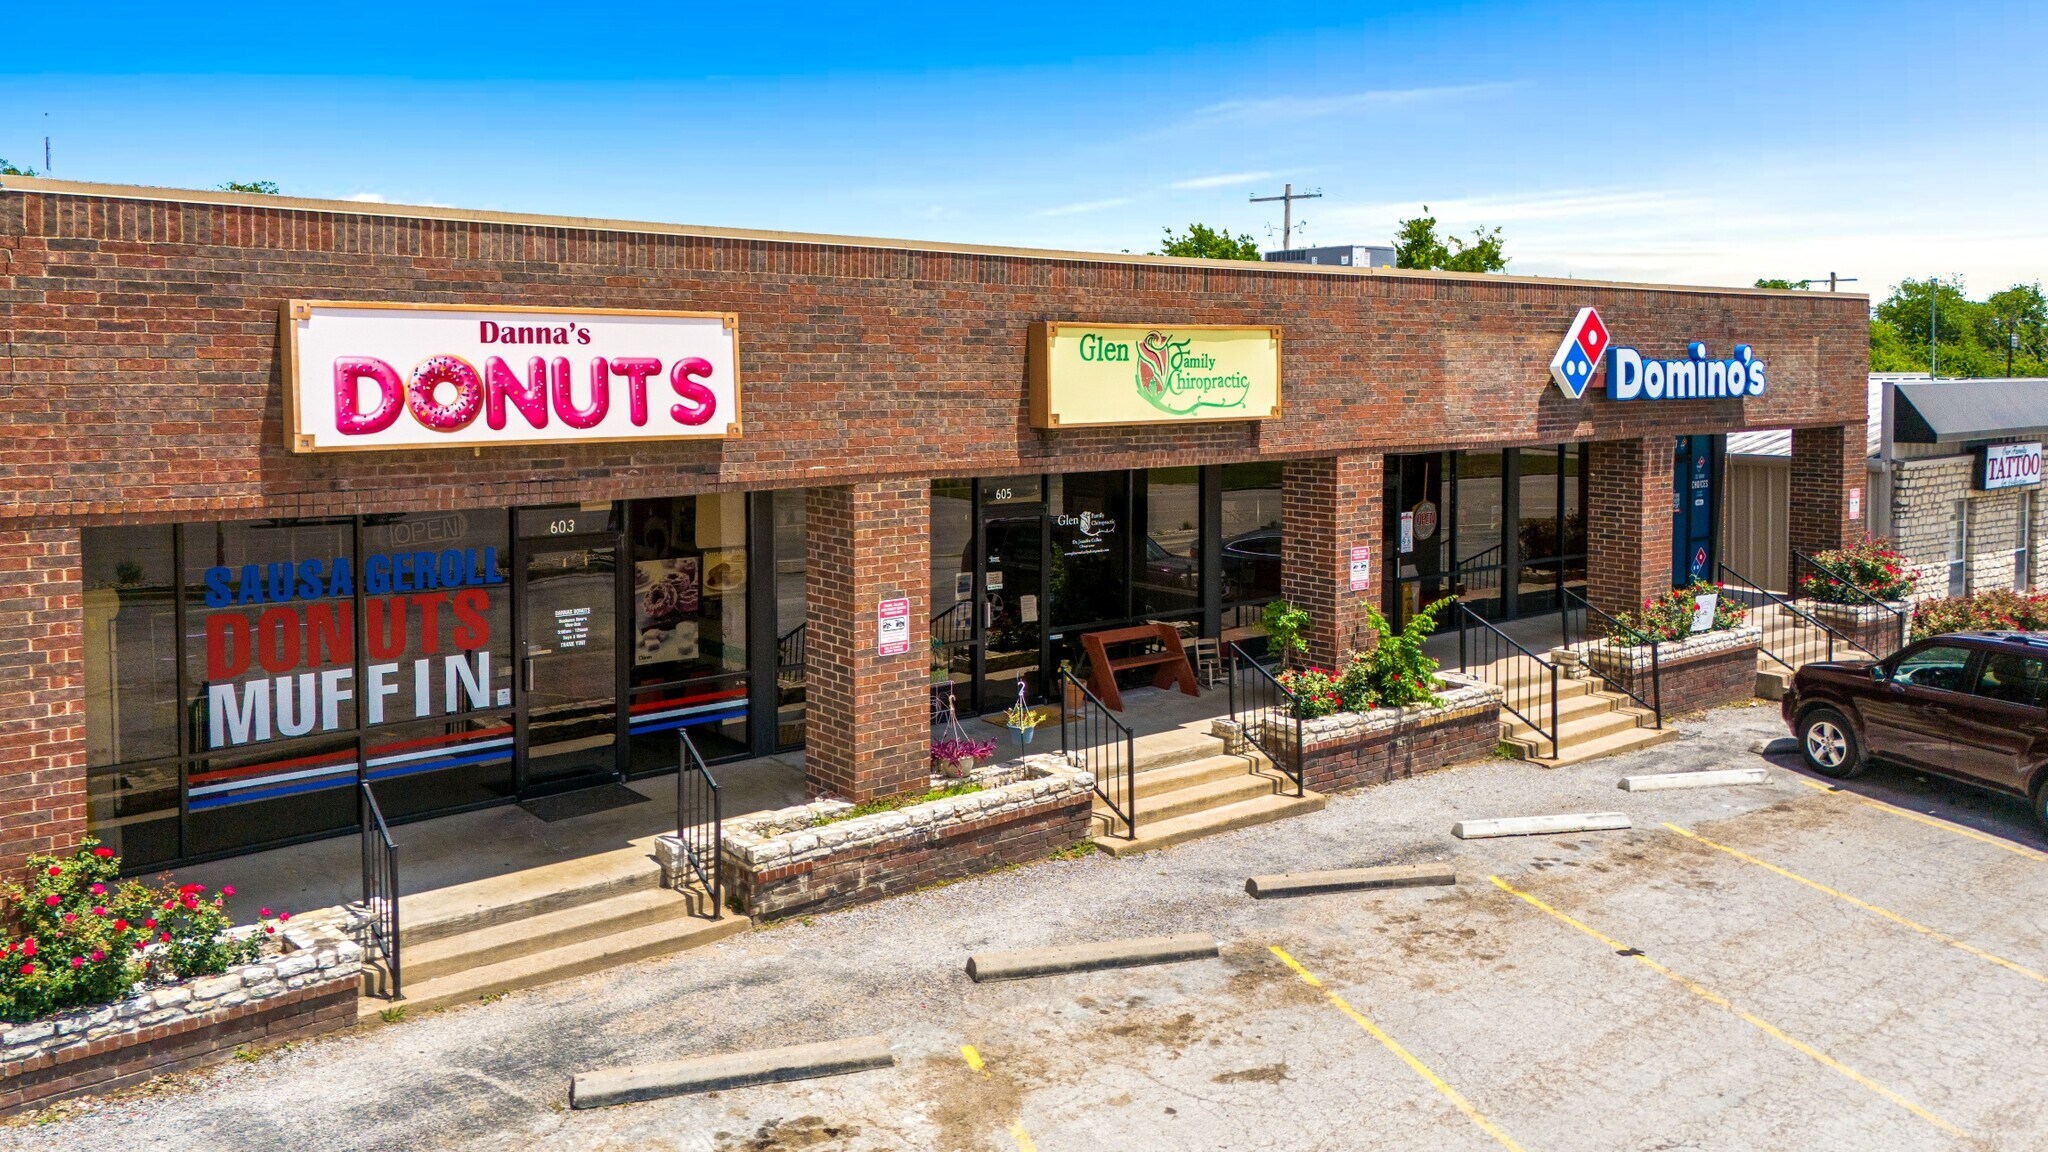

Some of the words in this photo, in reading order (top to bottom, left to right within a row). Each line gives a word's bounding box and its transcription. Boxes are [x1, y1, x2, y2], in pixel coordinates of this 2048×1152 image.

[480, 321, 591, 345] Danna's
[1079, 333, 1130, 362] Glen
[1171, 338, 1217, 372] Family
[1169, 370, 1249, 396] Chiropractic
[1606, 341, 1766, 400] Domino's
[333, 353, 717, 436] DONUTS
[1988, 453, 2040, 480] TATTOO
[996, 488, 1012, 500] 605
[394, 517, 458, 543] OPEN
[550, 519, 575, 534] 603
[1057, 514, 1079, 526] Glen
[205, 589, 490, 680] DONUTS
